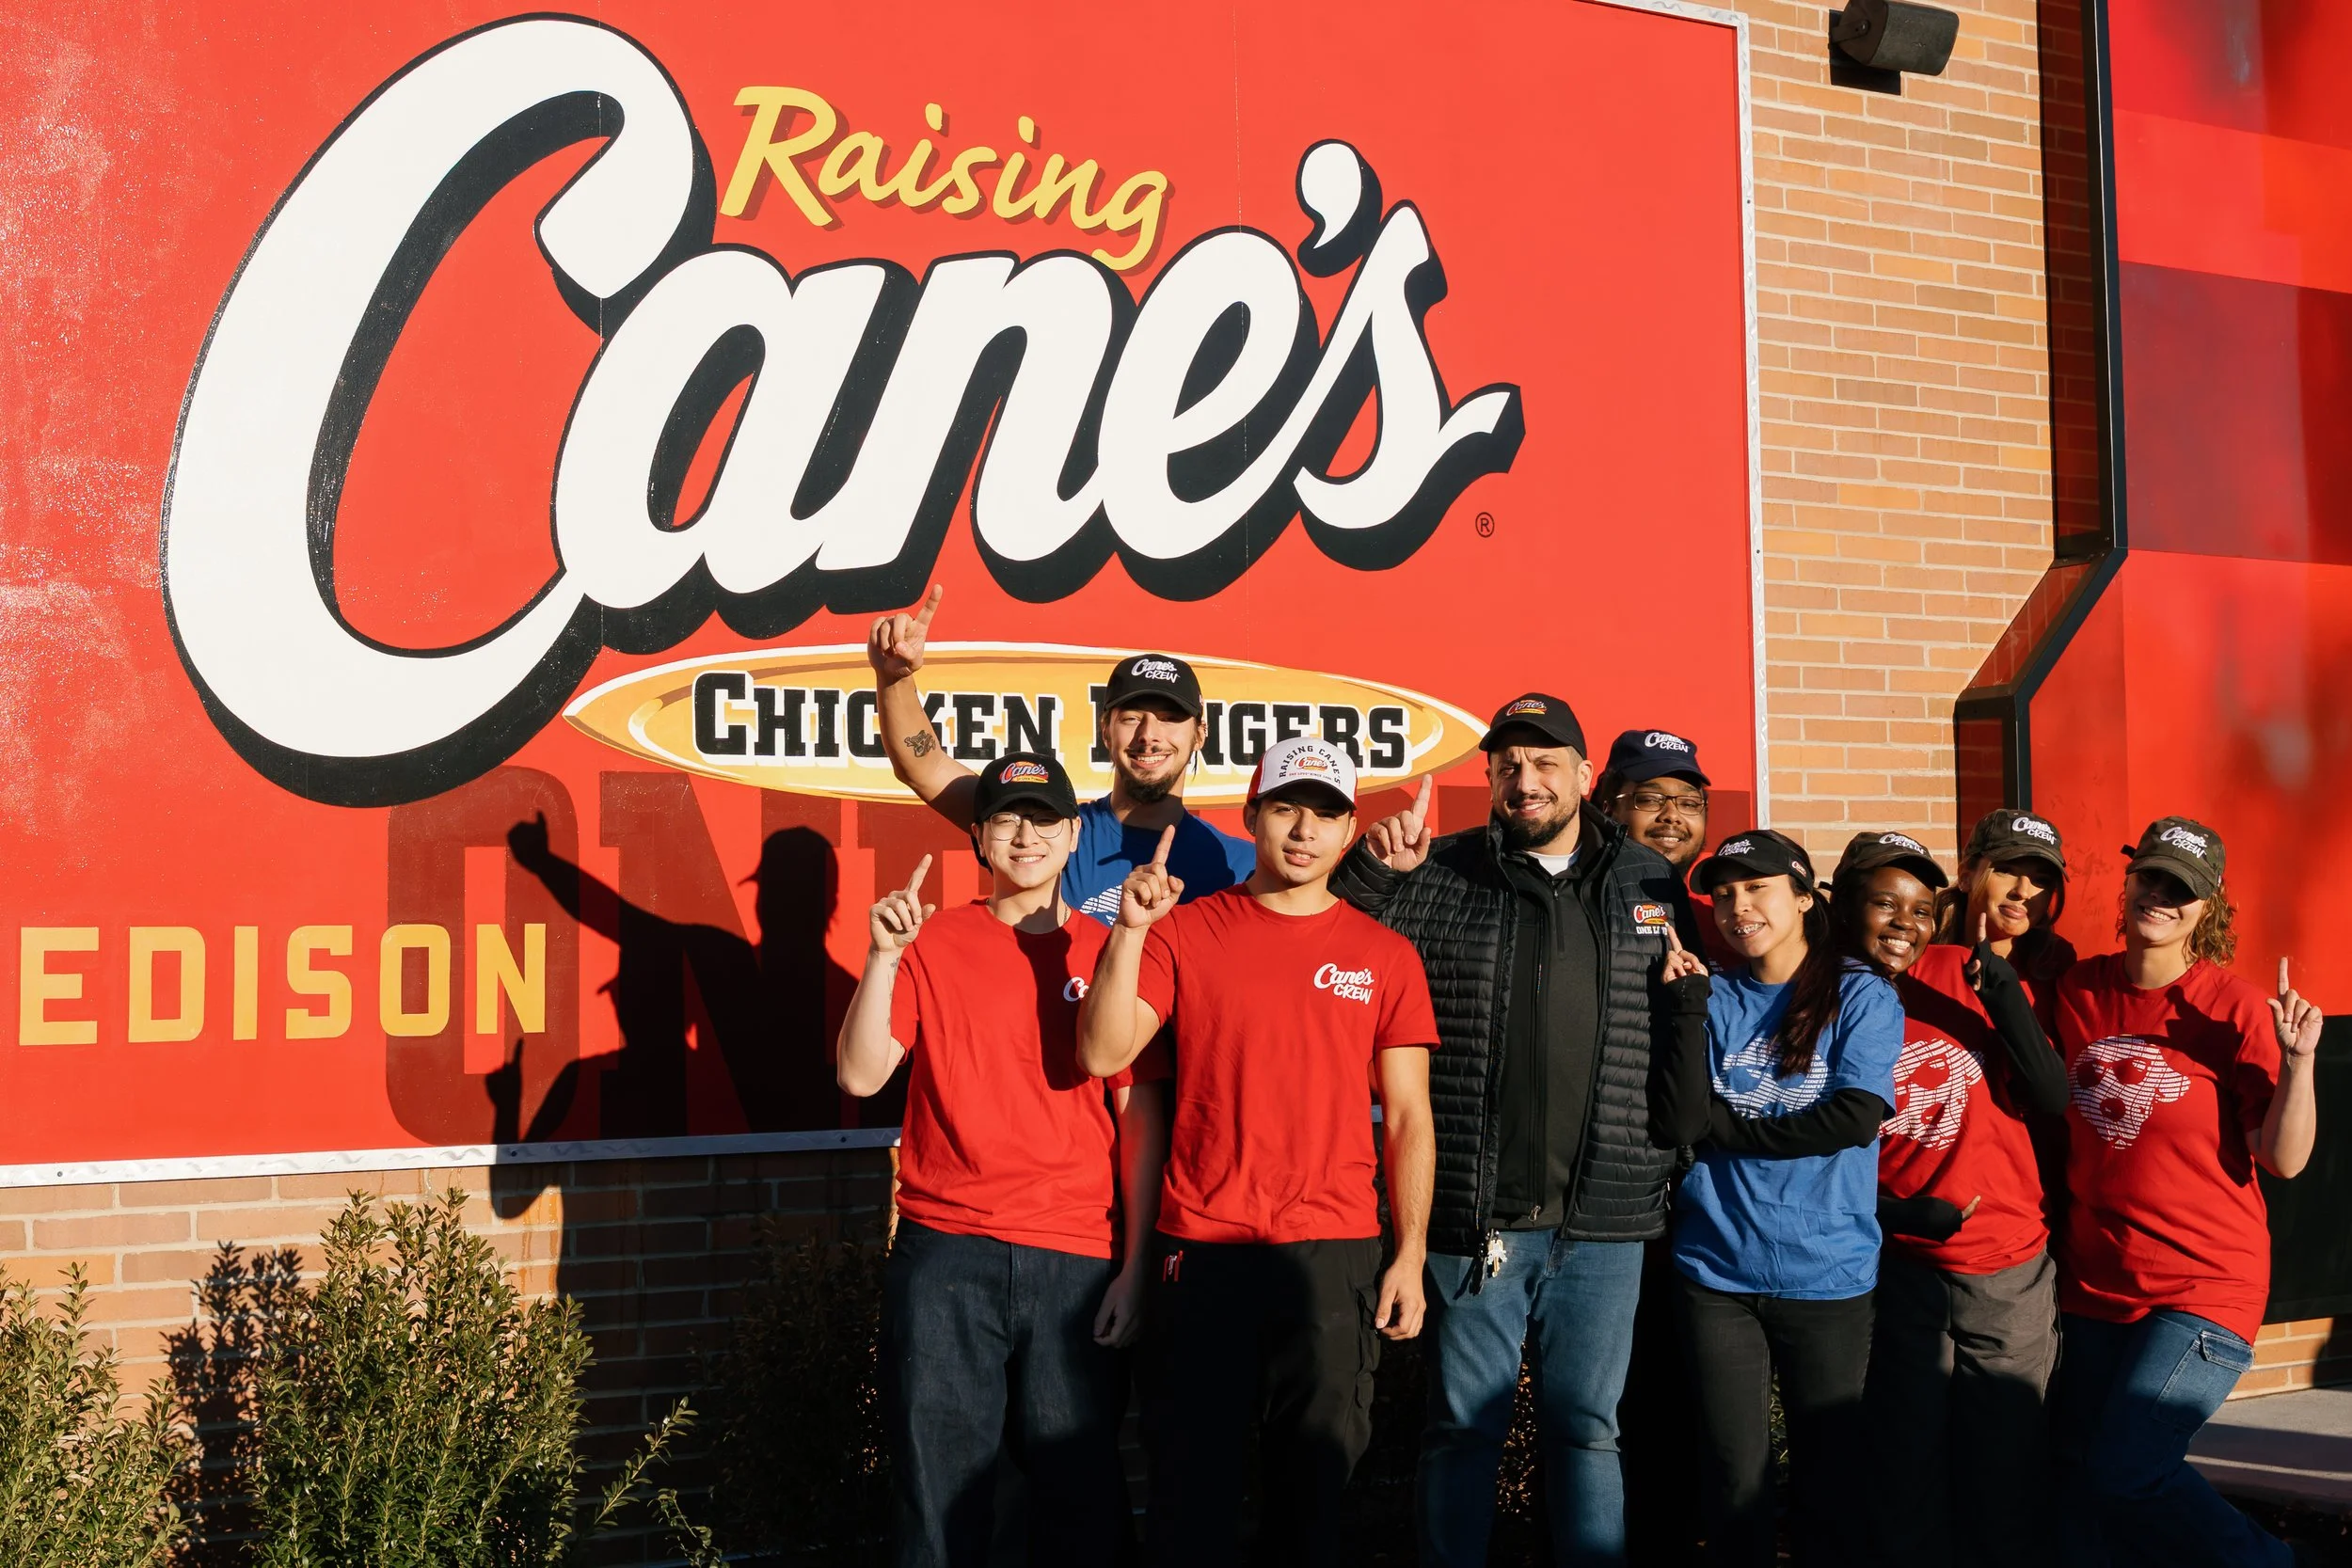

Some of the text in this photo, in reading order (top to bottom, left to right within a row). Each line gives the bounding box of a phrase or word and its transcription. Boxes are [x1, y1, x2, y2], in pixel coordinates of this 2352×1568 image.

[720, 86, 1168, 270] Raising
[161, 11, 1525, 807] Cane's
[1131, 658, 1177, 676] Cane's
[1145, 670, 1181, 684] CREW
[1660, 741, 1689, 753] CREW
[1279, 745, 1313, 779] RAISING
[1000, 763, 1046, 784] Cane's
[2027, 829, 2057, 845] CREW
[2172, 838, 2207, 858] CREW
[1633, 904, 1666, 924] Cane's
[1636, 927, 1652, 935] ONE
[19, 923, 547, 1045] EDISON
[1313, 963, 1375, 989] Cane's
[1333, 984, 1374, 1005] CREW
